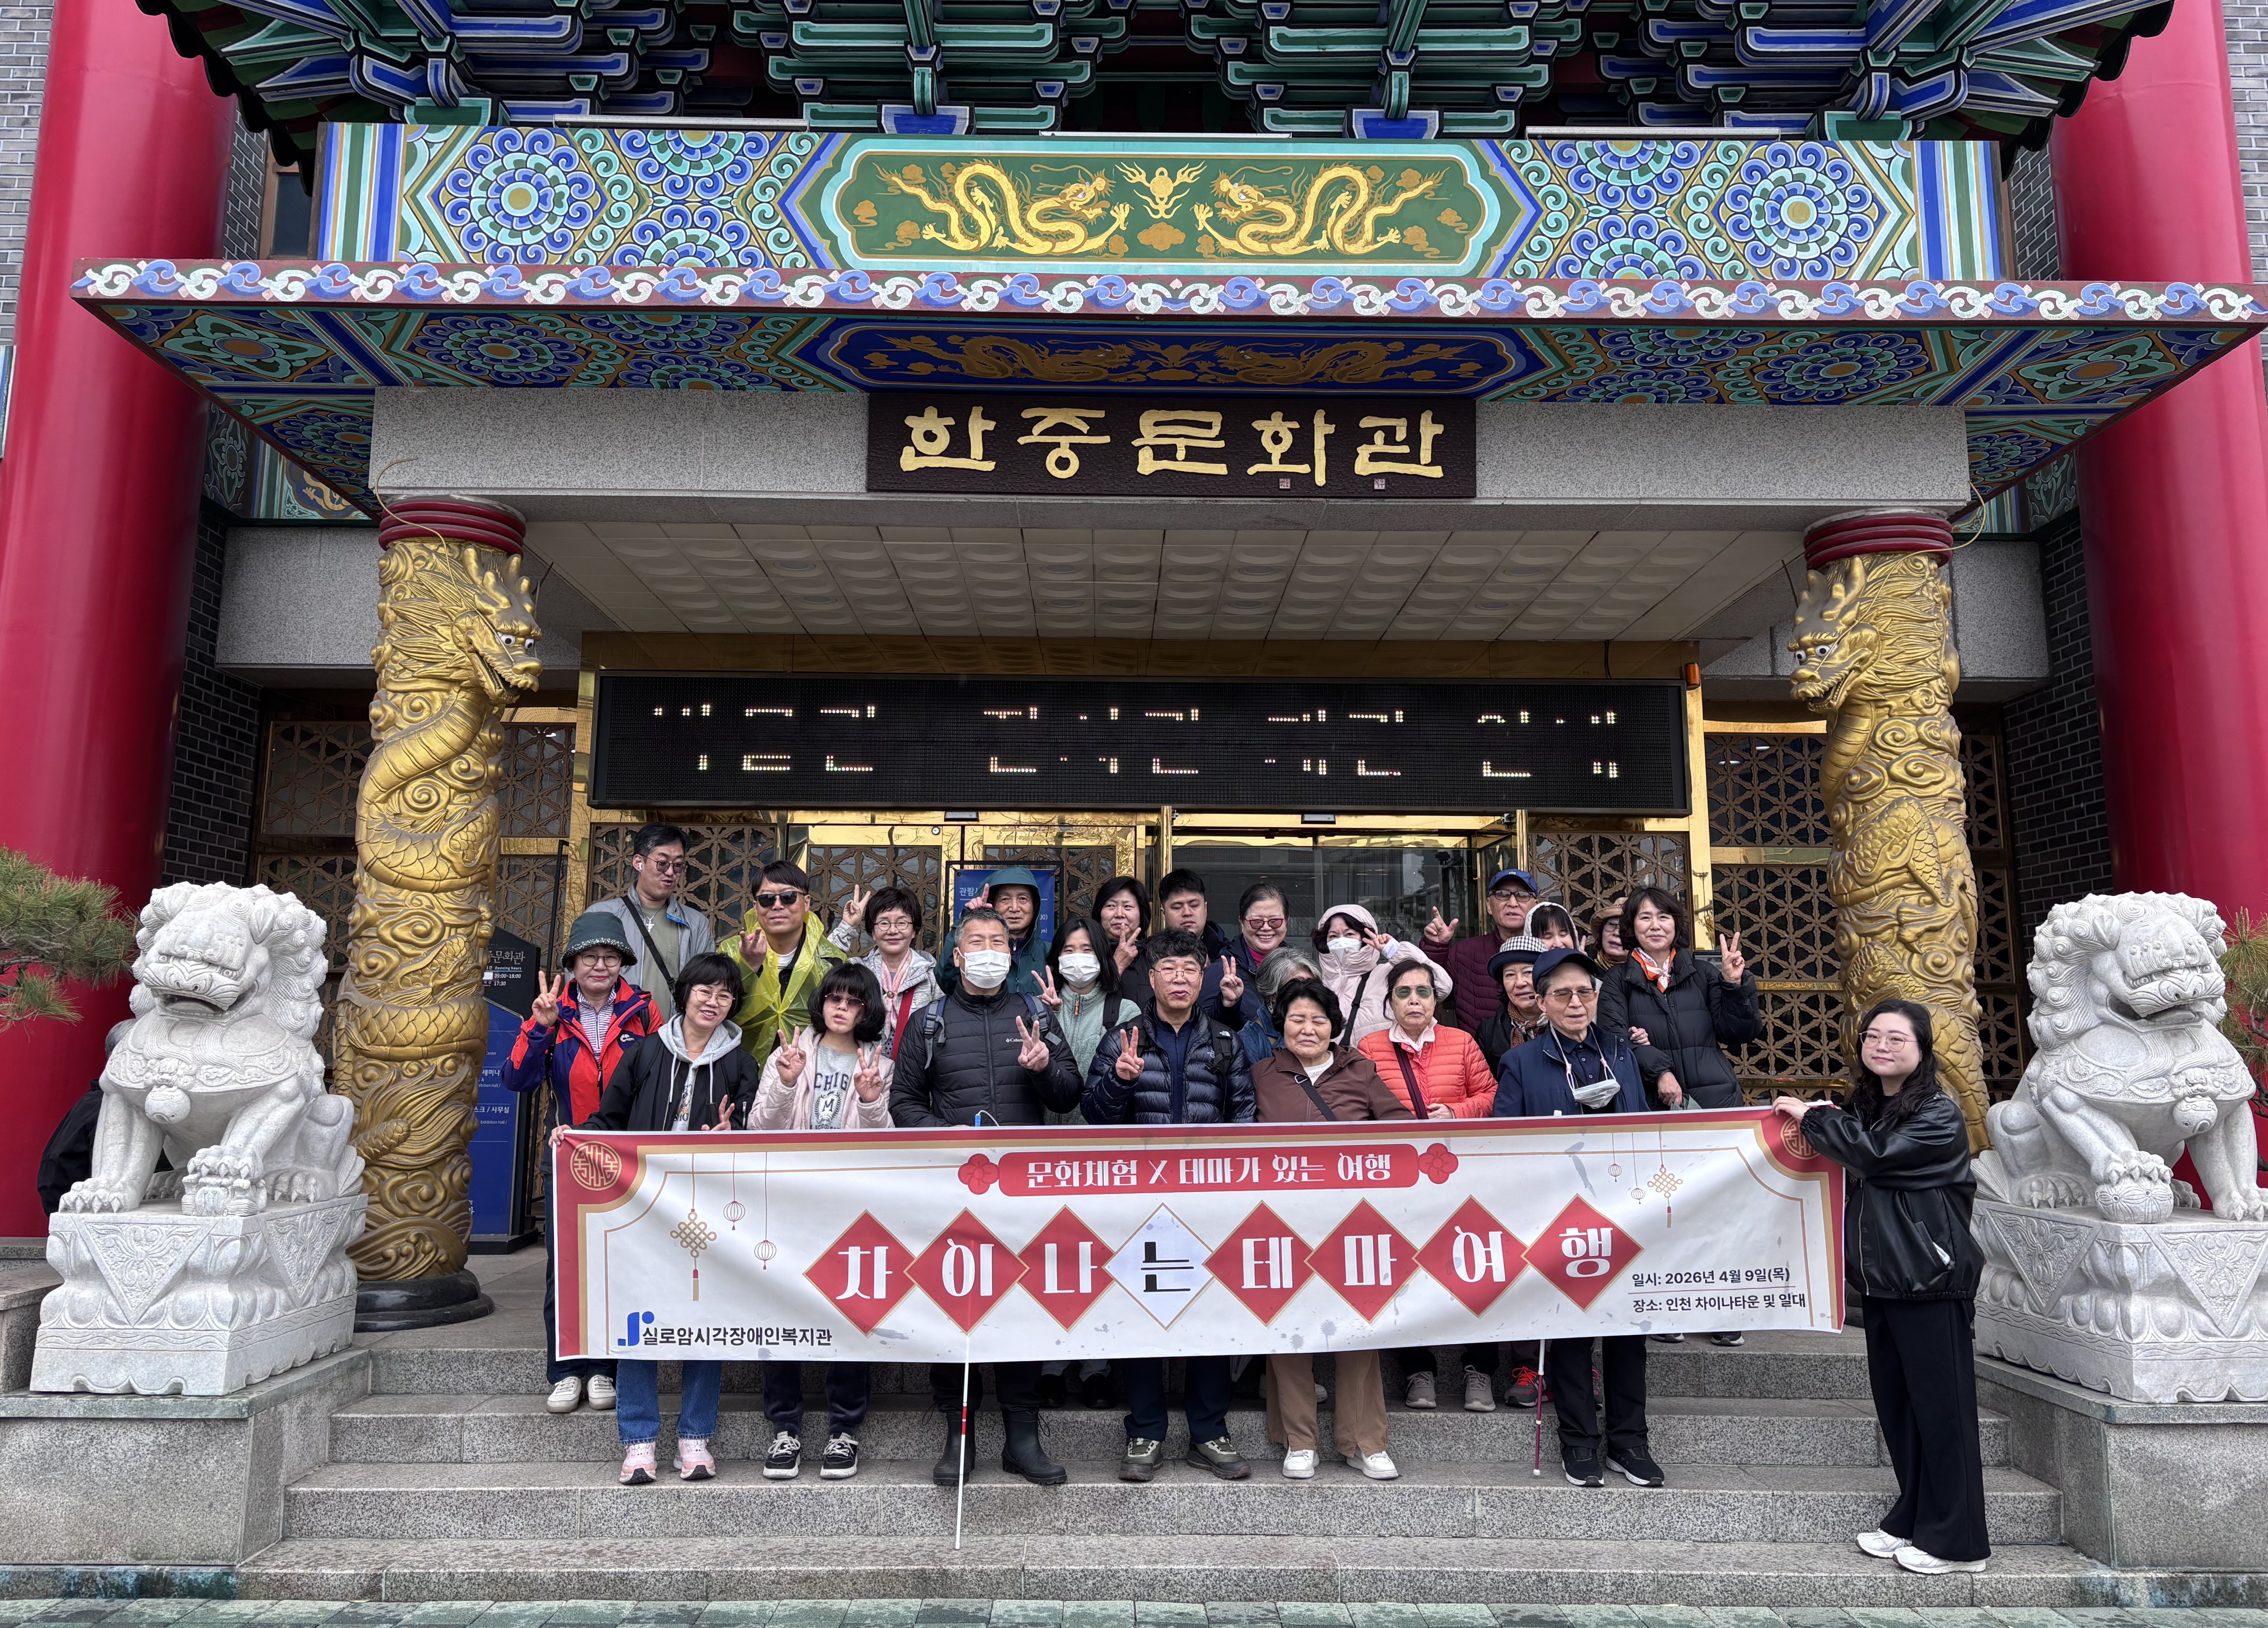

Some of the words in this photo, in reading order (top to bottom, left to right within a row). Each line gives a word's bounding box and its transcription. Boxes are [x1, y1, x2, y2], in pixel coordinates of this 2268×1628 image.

[900, 406, 1444, 486] 한중문화관
[488, 950, 526, 965] 문화관
[814, 1072, 849, 1091] CHIG
[822, 1098, 834, 1112] M
[1027, 1160, 1138, 1188] 문화체험
[1179, 1157, 1262, 1184] 테마가
[1272, 1154, 1326, 1183] 있는
[1338, 1153, 1391, 1181] 여행
[1632, 1272, 1661, 1287] 일시:
[1665, 1270, 1715, 1284] 2026년
[1719, 1269, 1741, 1283] 4월
[1745, 1268, 1790, 1283] 9일(목)
[1633, 1299, 1662, 1313] 장소:
[1666, 1297, 1691, 1311] 인천
[1695, 1295, 1760, 1310] 차이나타운
[1763, 1294, 1775, 1308] 및
[1779, 1293, 1806, 1308] 일대
[643, 1327, 832, 1346] 실로암시각장애인복지관
